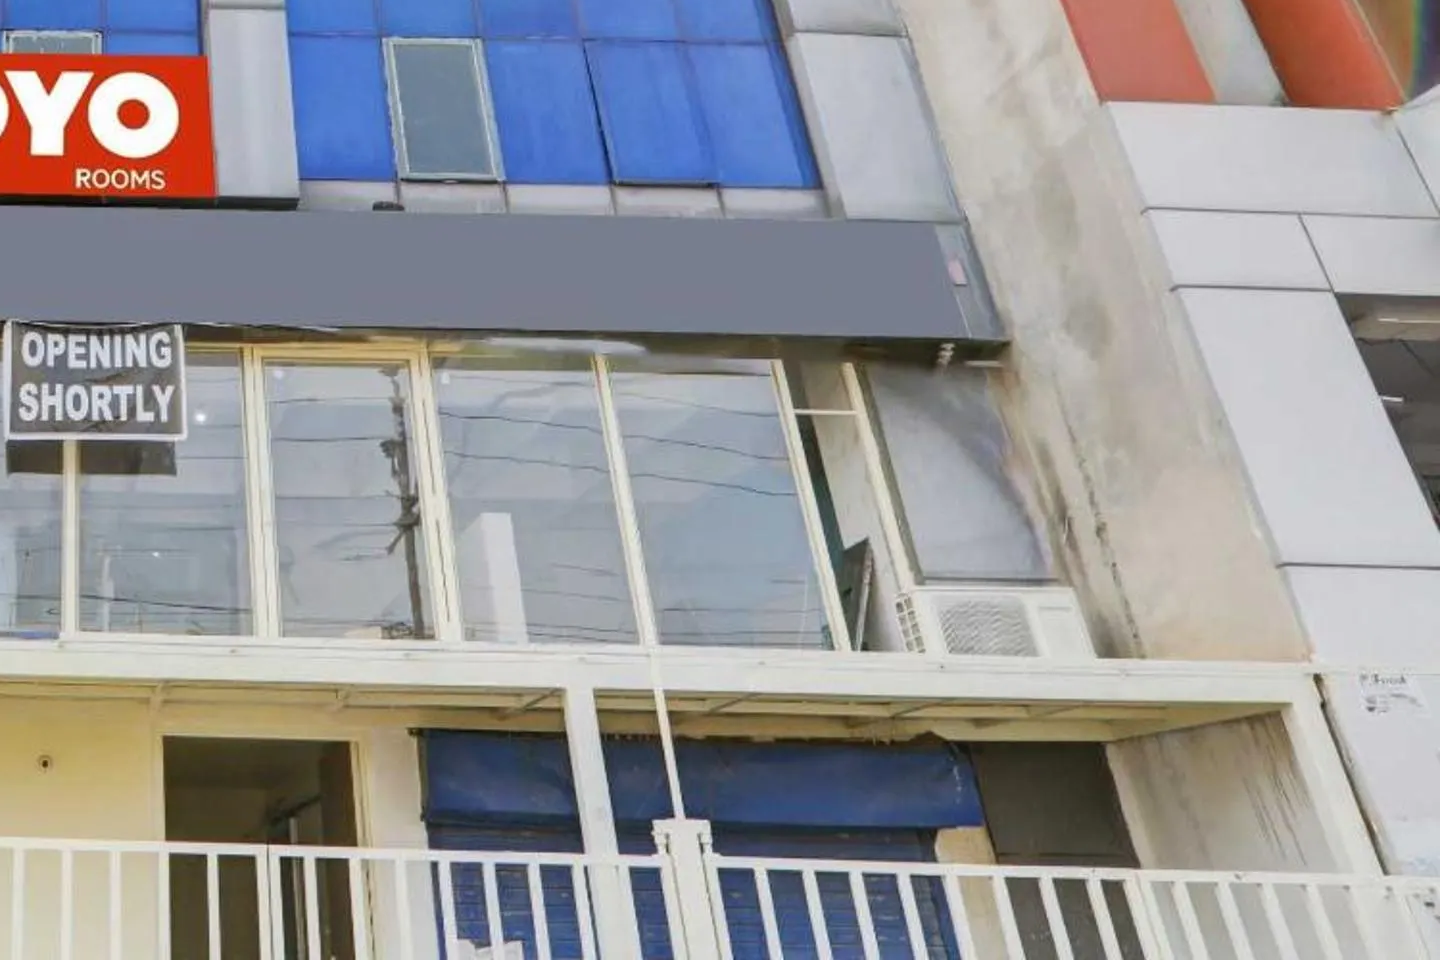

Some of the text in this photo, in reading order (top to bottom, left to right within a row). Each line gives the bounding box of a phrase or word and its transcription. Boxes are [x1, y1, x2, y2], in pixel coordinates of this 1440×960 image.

[75, 168, 166, 190] ROOMS
[21, 331, 173, 368] OPENING
[18, 382, 176, 422] SHORTLY
